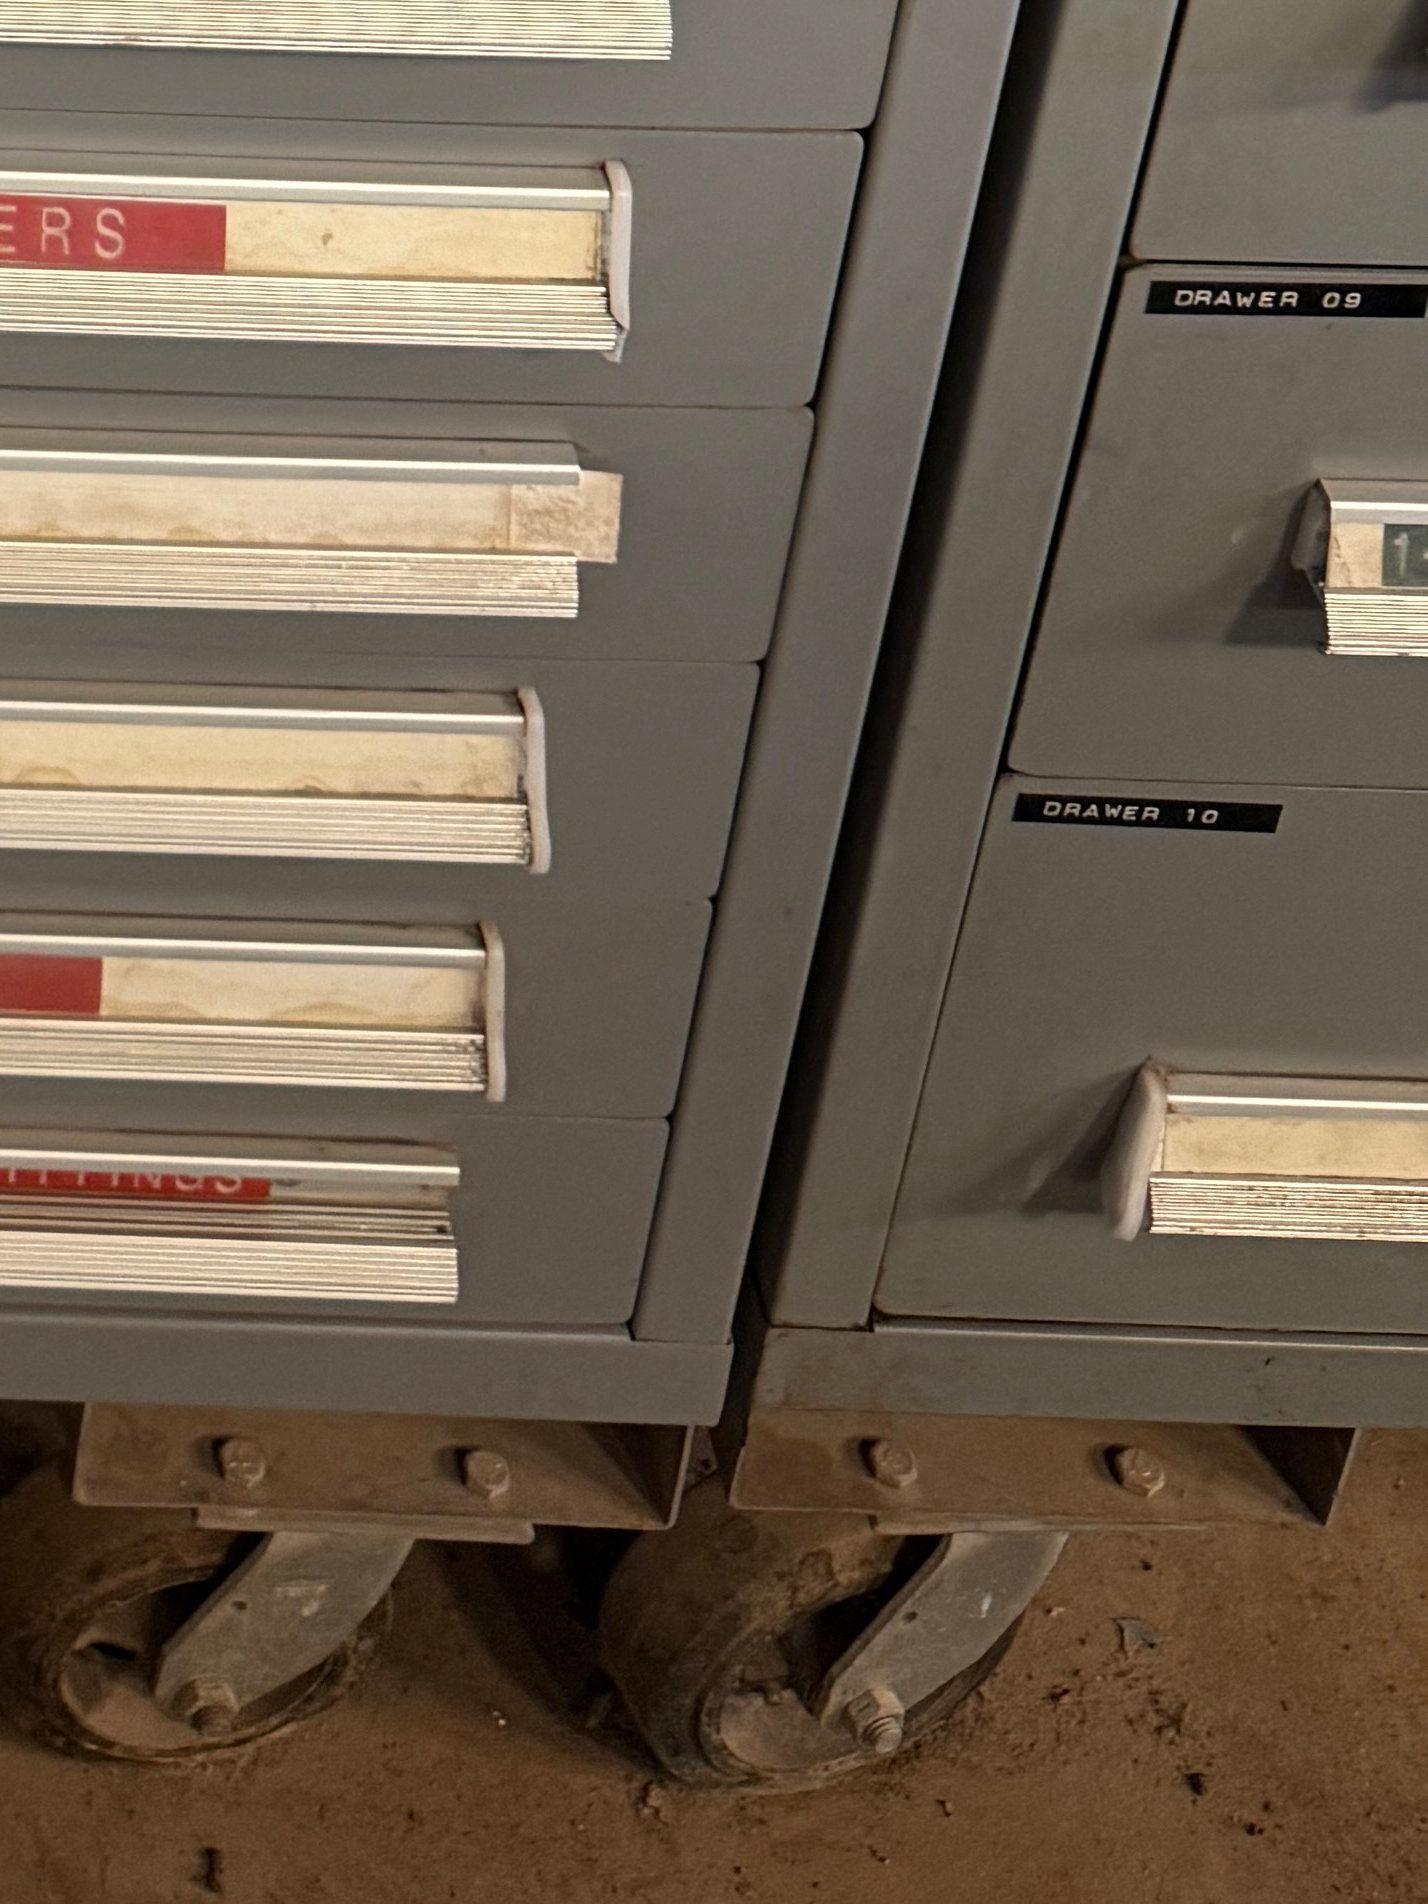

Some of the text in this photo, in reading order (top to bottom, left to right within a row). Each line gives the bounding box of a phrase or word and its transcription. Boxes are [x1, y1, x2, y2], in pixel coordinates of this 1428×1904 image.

[1174, 290, 1362, 309] DRAWER 09
[1043, 800, 1219, 824] DRAWER 10
